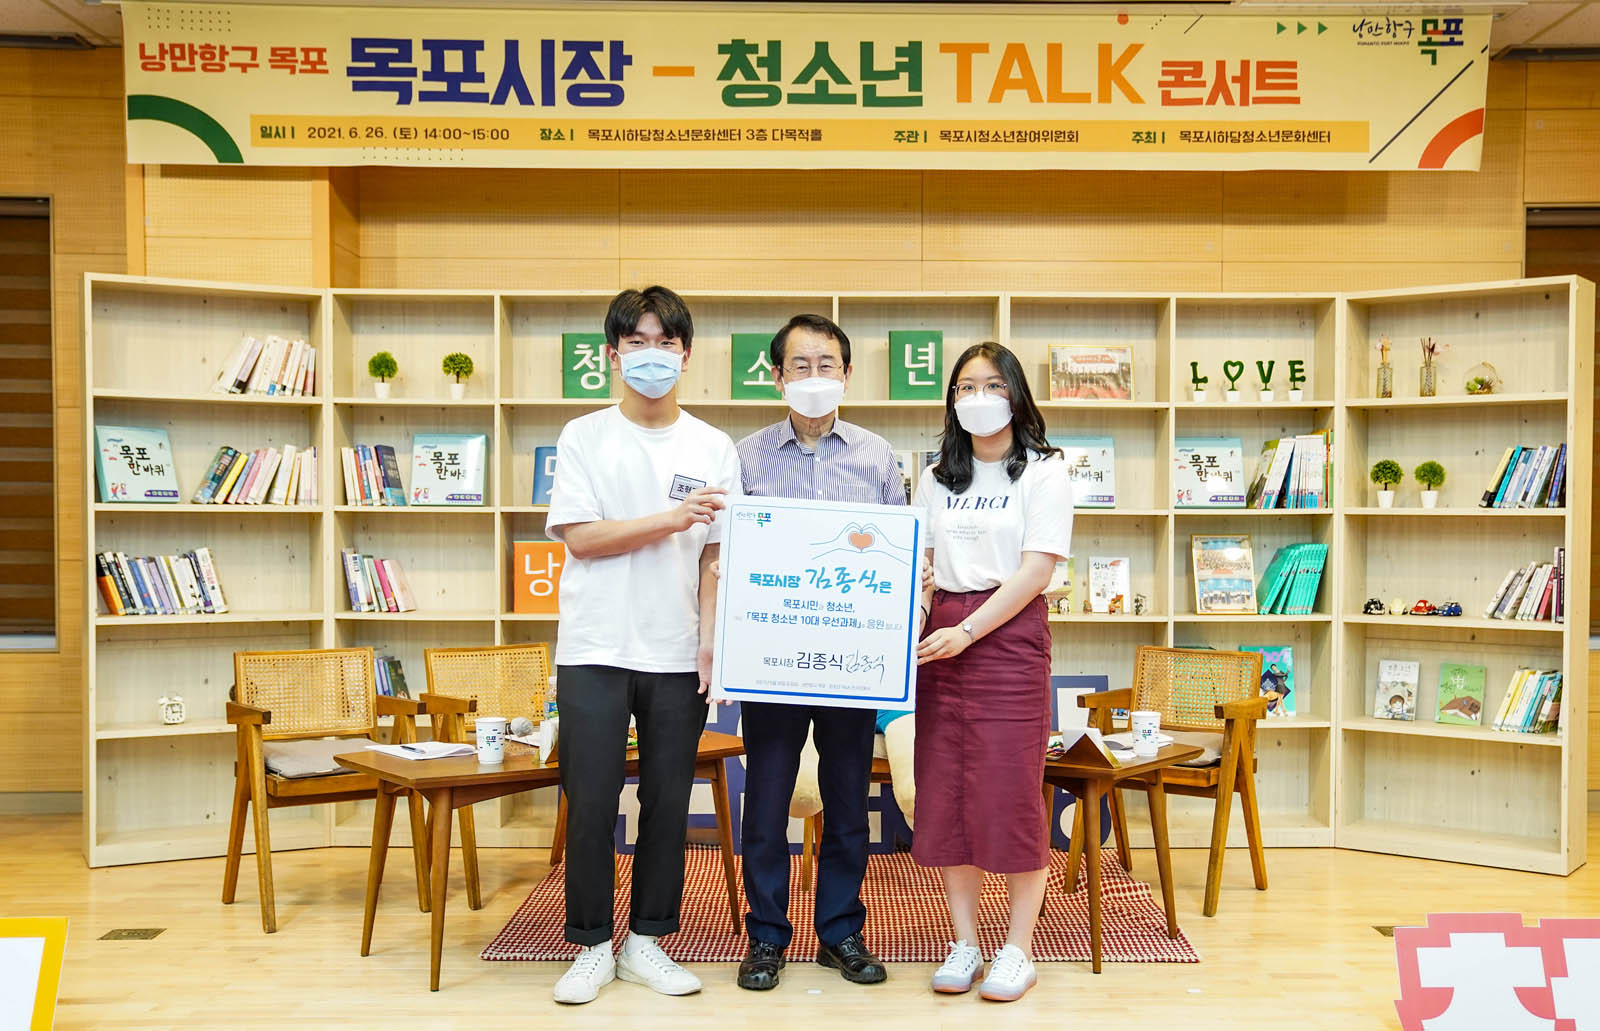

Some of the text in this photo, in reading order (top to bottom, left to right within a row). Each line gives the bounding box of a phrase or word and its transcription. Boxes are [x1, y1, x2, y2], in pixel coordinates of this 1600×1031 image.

[1418, 18, 1464, 65] 목포
[138, 42, 260, 74] 낭만항구
[267, 43, 329, 75] 목포
[346, 37, 633, 108] 목포시장
[716, 38, 924, 108] 청소년
[939, 43, 1146, 105] TALK
[1158, 59, 1301, 107] 콘서트
[307, 126, 346, 141] 2021.
[348, 126, 361, 140] 6.
[364, 126, 388, 140] 26.
[392, 126, 419, 141] (토)
[423, 127, 511, 142] 14:00~15:00
[587, 127, 742, 143] 목포시하당청소년문화센터
[745, 128, 768, 142] 3층
[771, 128, 823, 143] 다목적홀
[938, 129, 1080, 145] 목포시청소년참여위원회
[1178, 129, 1332, 145] 목포시하당청소년문화센터
[573, 343, 606, 390] 청
[904, 341, 936, 387] 년
[120, 444, 151, 463] 목포
[430, 451, 461, 468] 목포
[1189, 454, 1220, 471] 목포
[450, 468, 466, 480] 바
[947, 495, 1010, 510] MERCI
[525, 551, 561, 597] 낭
[748, 573, 801, 589] 목포시장
[826, 601, 856, 613] 청소년,
[771, 613, 798, 625] 청소년
[800, 615, 820, 626] 10대
[763, 651, 844, 671] 목포시장 김종식
